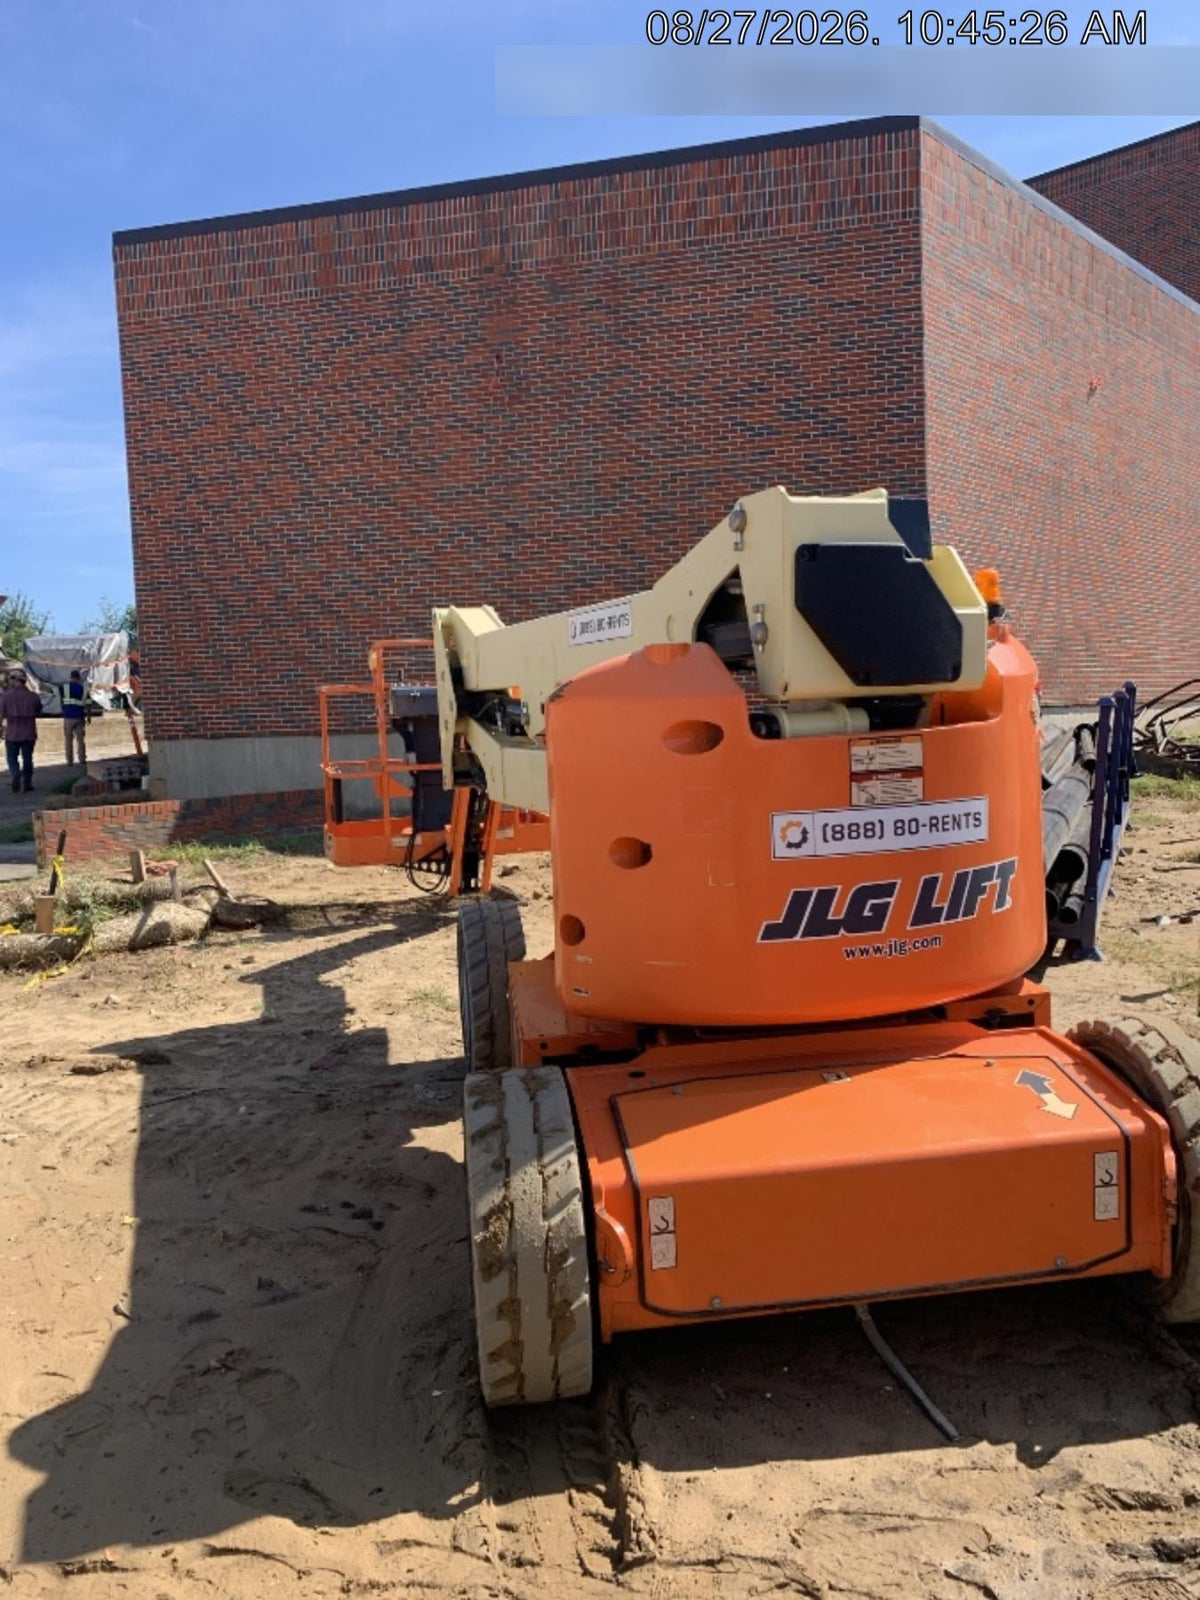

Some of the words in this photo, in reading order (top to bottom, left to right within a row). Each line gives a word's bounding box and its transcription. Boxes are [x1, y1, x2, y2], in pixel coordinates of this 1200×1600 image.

[822, 819, 884, 843] (888)
[893, 811, 982, 837] 80-RENTS
[757, 879, 901, 943] JLG
[906, 857, 1018, 930] LIFT
[843, 934, 942, 959] www.jlg.com
